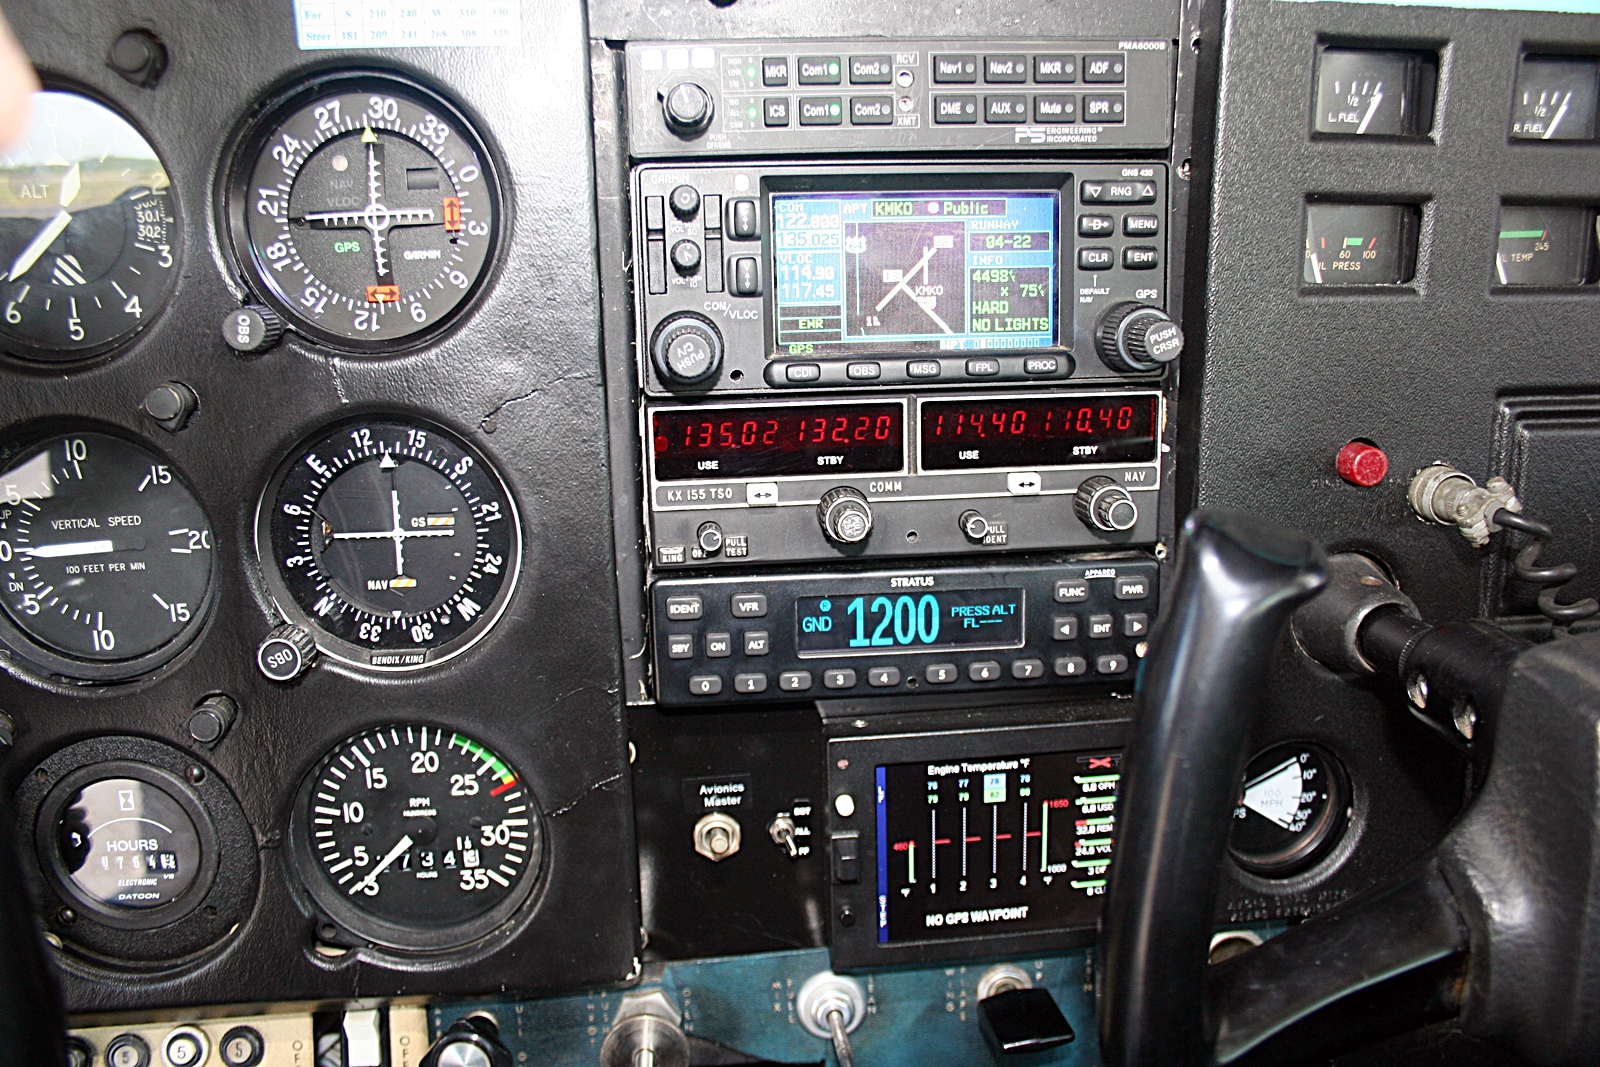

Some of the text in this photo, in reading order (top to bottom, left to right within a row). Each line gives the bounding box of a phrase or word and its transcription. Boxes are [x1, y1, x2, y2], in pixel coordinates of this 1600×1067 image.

[305, 9, 387, 20] For 210
[306, 30, 417, 42] Steer 181 209 241
[765, 67, 787, 78] MKR
[802, 65, 827, 77] Com1
[853, 63, 879, 75] Com2
[940, 62, 962, 74] Nav1
[990, 62, 1013, 74] Nav2
[1040, 62, 1061, 74] MKR
[1089, 62, 1109, 74] ADF
[368, 97, 398, 121] 30
[769, 106, 785, 117] ICS
[804, 105, 828, 117] Com1
[855, 104, 880, 116] Com2
[940, 102, 961, 115] DME
[991, 102, 1010, 114] AUX
[1040, 102, 1061, 114] Mute
[1089, 101, 1109, 113] SPR
[315, 100, 343, 132] 27
[897, 116, 917, 126] XMT
[1338, 113, 1359, 123] FUEL
[417, 113, 450, 144] 33
[1523, 124, 1544, 133] FUEL
[1046, 135, 1097, 143] INCORPORATED
[272, 134, 302, 163] 24
[1121, 169, 1138, 177] GNS
[21, 184, 50, 199] ALT
[1110, 187, 1132, 196] RNG
[843, 202, 989, 215] APT KMKO Public
[137, 209, 160, 224] 30.1
[777, 215, 840, 229] 122.800
[1129, 219, 1157, 229] MENU
[138, 225, 162, 240] 30.2
[778, 233, 840, 247] 135.025
[985, 235, 1031, 248] 04-22
[334, 242, 361, 253] GPS
[1535, 242, 1548, 251] 245
[158, 245, 173, 267] 3
[403, 250, 441, 260] GARMIN
[780, 254, 813, 264] VLOC
[972, 255, 1003, 265] INFO
[1088, 253, 1108, 263] CLR
[1134, 253, 1153, 262] ENT
[1339, 250, 1350, 259] 60
[1363, 250, 1376, 259] 100
[1511, 253, 1533, 262] TEMP
[1333, 261, 1361, 271] PRESS
[781, 265, 834, 280] 114.90
[781, 283, 835, 298] 117.45
[915, 285, 943, 296] KMKO
[1136, 289, 1157, 299] GPS
[6, 301, 21, 324] 6
[125, 296, 142, 318] 4
[972, 301, 1009, 314] HARD
[69, 318, 84, 340] 5
[798, 319, 824, 329] ENR
[972, 317, 1049, 332] NO LIGHTS
[1149, 326, 1177, 344] PUSH
[789, 345, 813, 354] GPS
[1153, 337, 1180, 355] CRSR
[913, 365, 937, 374] MSG
[975, 363, 993, 372] FPL
[1028, 360, 1056, 370] PROC
[794, 369, 812, 378] CDI
[853, 367, 876, 376] OBS
[935, 406, 1132, 438] 114.40 110.40
[685, 415, 891, 448] 135.02 132.20
[351, 428, 373, 448] 12
[407, 430, 427, 449] 15
[65, 440, 87, 461] 10
[959, 450, 979, 460] USE
[1072, 446, 1098, 456] STBY
[697, 461, 719, 470] USE
[817, 456, 844, 465] STBY
[151, 465, 171, 485] 15
[1125, 471, 1146, 482] NAV
[869, 482, 902, 493] COMM
[6, 485, 21, 505] 5
[667, 488, 733, 501] KX 155 TSO
[51, 516, 142, 530] VERTICAL SPEED
[725, 538, 747, 547] PULL
[725, 547, 747, 556] TEST
[662, 554, 683, 563] KING
[66, 562, 146, 574] 100 FEET PER MIN
[367, 580, 389, 590] NAV
[891, 576, 934, 587] STRATUS
[1059, 587, 1085, 597] FUNC
[1122, 585, 1144, 594] PWR
[24, 594, 40, 614] 5
[670, 603, 699, 614] IDENT
[739, 602, 759, 612] VFR
[169, 602, 190, 622] 15
[951, 604, 1016, 617] PRESS ALT
[802, 616, 832, 632] GND
[847, 594, 940, 648] 1200
[1093, 624, 1110, 633] ENT
[93, 630, 115, 651] 10
[710, 642, 726, 651] ON
[748, 640, 765, 649] ALT
[672, 644, 689, 653] SBY
[267, 647, 293, 669] OBS
[410, 751, 439, 773] 20
[927, 760, 1019, 777] Engine Temperature
[1303, 769, 1317, 780] 10°
[365, 767, 388, 789] 15
[958, 779, 969, 787] 77
[450, 774, 479, 797] 25
[700, 783, 745, 796] Avionics
[409, 797, 430, 808] RPM
[704, 796, 742, 807] Master
[1301, 791, 1317, 802] 20°
[1050, 799, 1069, 808] 1650
[1261, 800, 1283, 808] MPH
[343, 801, 364, 824] 10
[480, 825, 510, 846] 30
[106, 839, 158, 852] HOURS
[353, 846, 369, 866] 5
[118, 878, 158, 887] ELECTRONIC
[460, 868, 489, 891] 35
[926, 906, 1028, 927] NO GPS WAYPOINT
